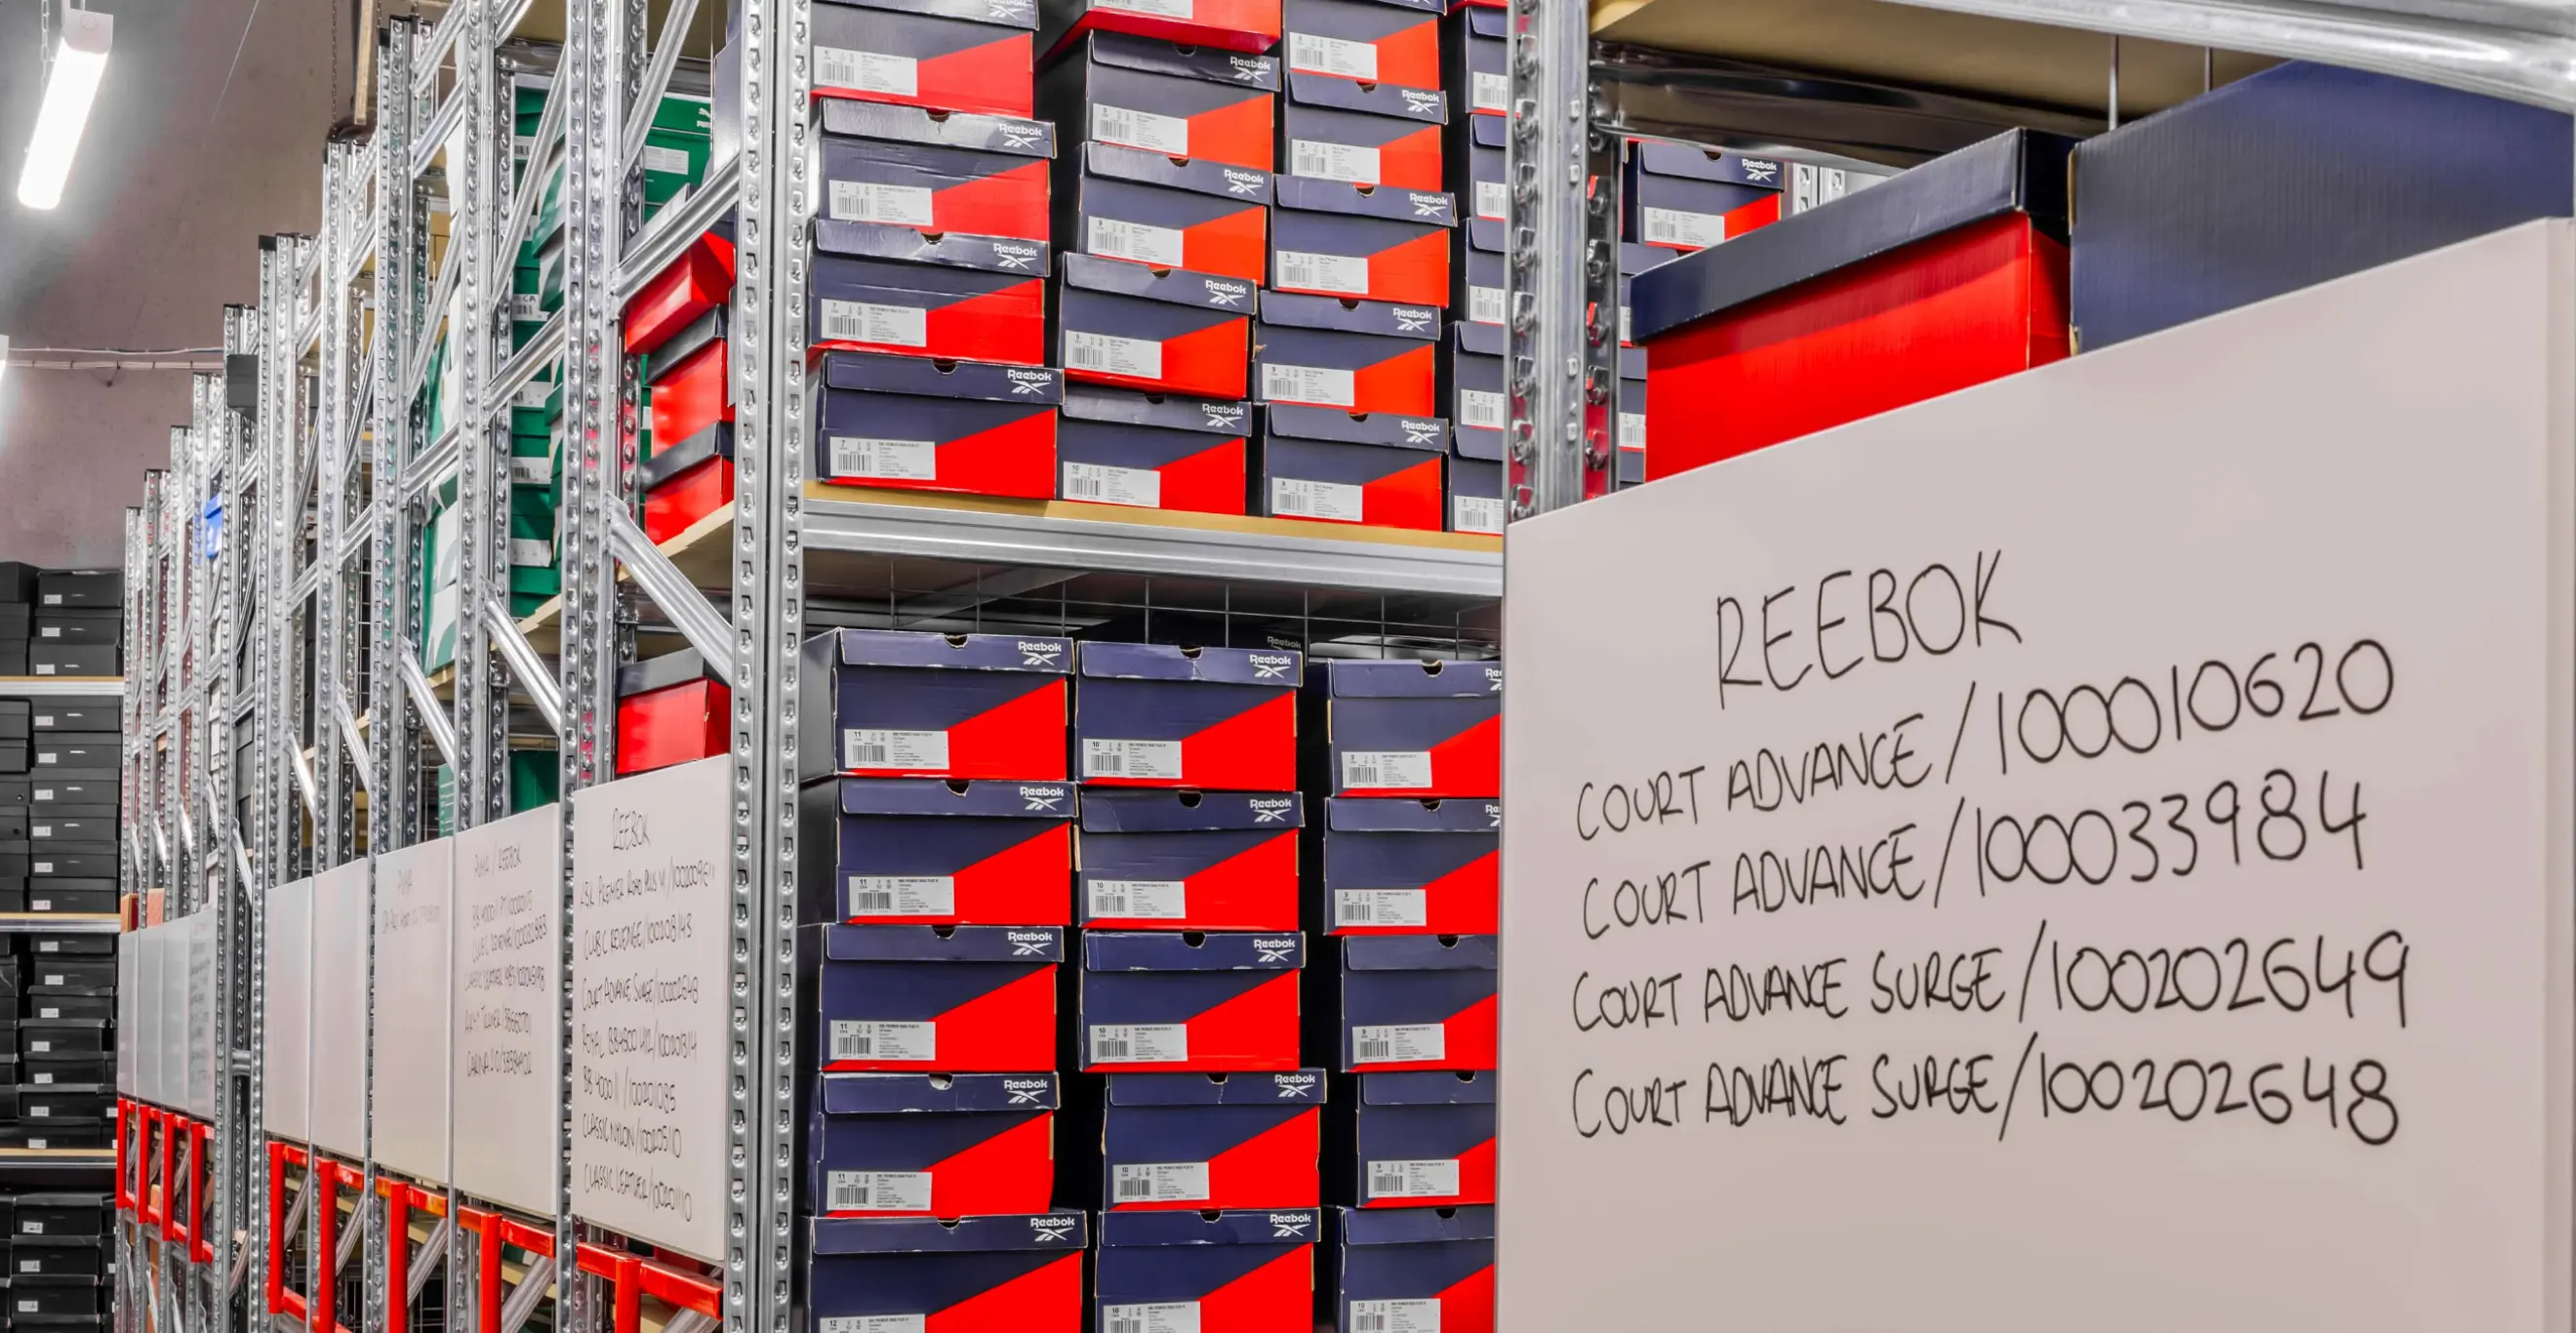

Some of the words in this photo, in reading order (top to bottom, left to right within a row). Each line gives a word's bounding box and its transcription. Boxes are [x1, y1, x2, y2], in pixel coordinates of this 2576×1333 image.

[1229, 56, 1270, 71] Reebok
[1401, 89, 1440, 103] Reebok
[999, 123, 1042, 138] Reebok
[1742, 158, 1777, 172] Reebok
[1224, 169, 1265, 184] Reebok
[1409, 192, 1448, 206] Reebok
[993, 243, 1037, 258] Reebok
[1205, 279, 1247, 295] Reebok
[1392, 307, 1432, 321] Reebok
[1008, 370, 1052, 382] Reebok
[1202, 403, 1244, 416] Reebok
[1401, 420, 1440, 433] Reebok
[1717, 549, 2022, 708] REEBOK
[1018, 641, 1063, 652] Reebok
[1267, 635, 1302, 649] Reebok
[1250, 655, 1292, 666] Reebok
[1576, 766, 1705, 840] COURT
[1727, 713, 1933, 812] ADVANCE
[1020, 787, 1065, 797] Reebok
[1250, 799, 1292, 810] Reebok
[612, 807, 650, 855] REEBOK
[1582, 861, 1711, 939] COURT
[1008, 931, 1053, 943] Reebok
[1254, 939, 1296, 949] Reebok
[1572, 971, 1682, 1031] COURT
[1704, 957, 1848, 1022] ADVANCE
[1004, 1079, 1048, 1091] Reebok
[1274, 1074, 1315, 1085] Reebok
[1572, 1068, 1686, 1138] COURT
[1705, 1055, 1847, 1125] ADVANCE
[1030, 1217, 1075, 1229] Reebok
[1269, 1213, 1311, 1225] Reebok
